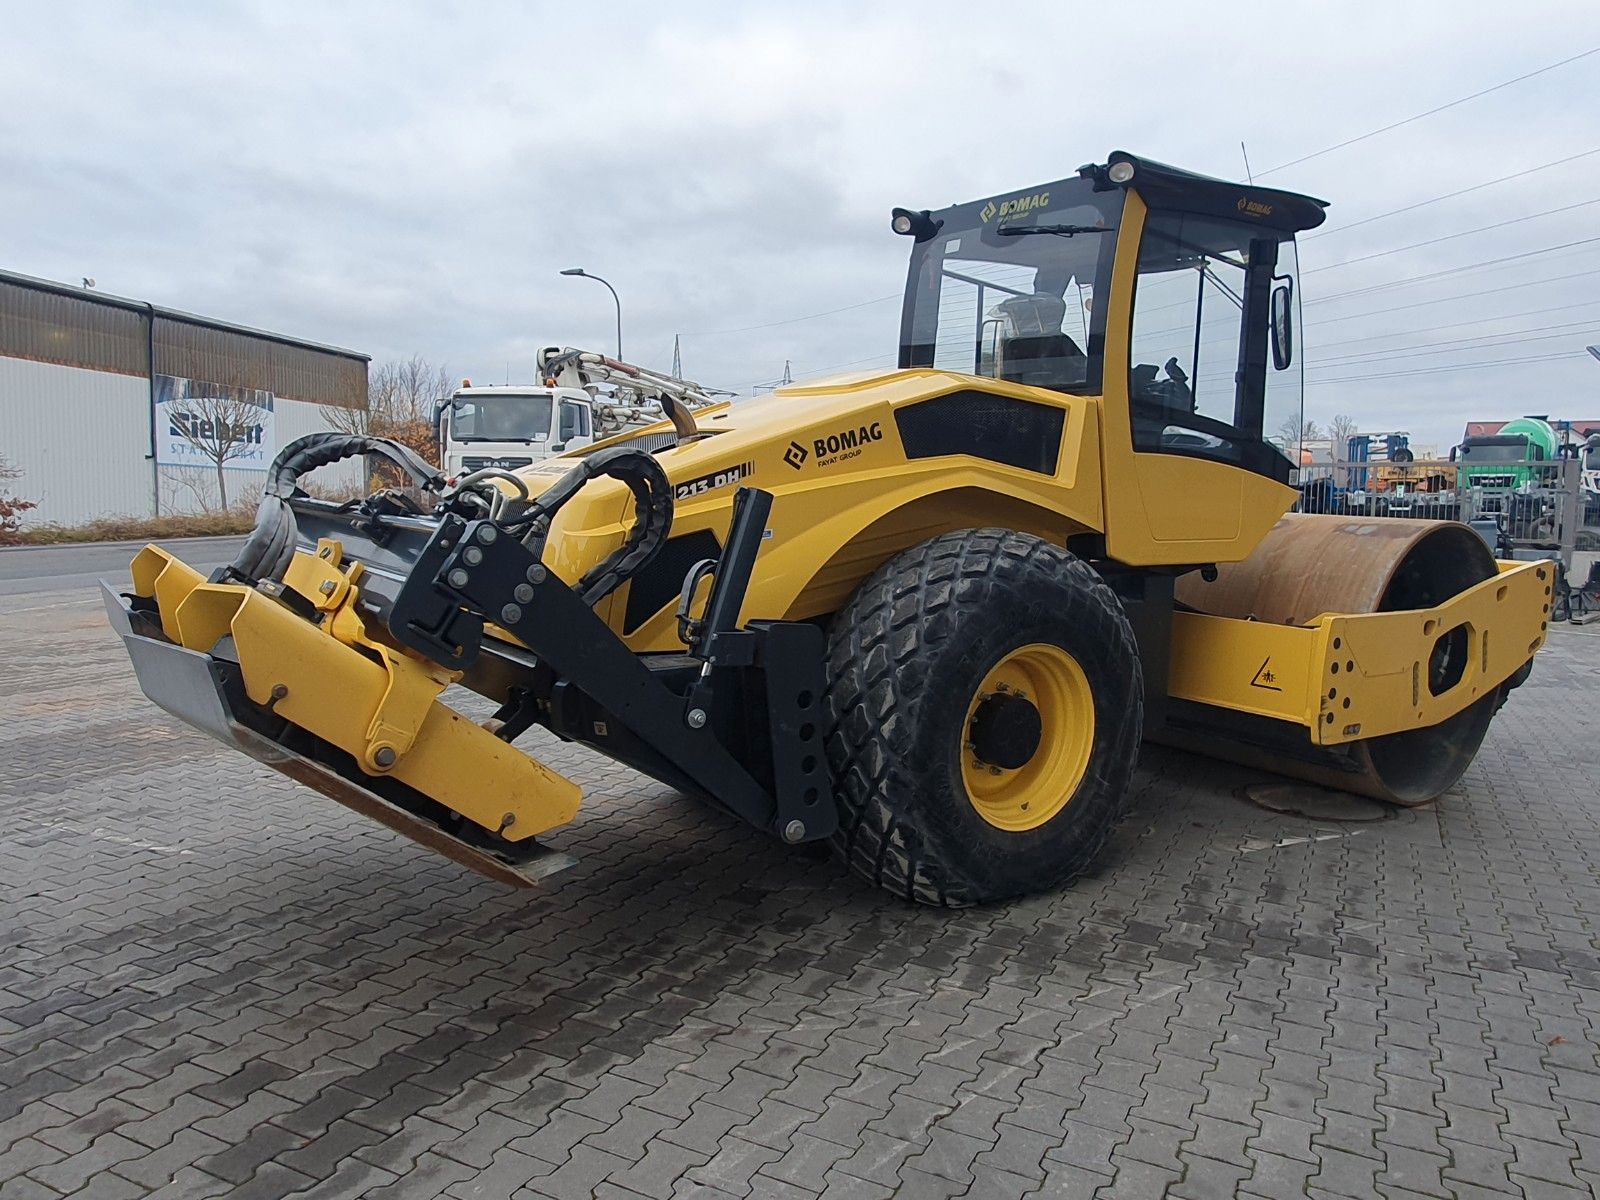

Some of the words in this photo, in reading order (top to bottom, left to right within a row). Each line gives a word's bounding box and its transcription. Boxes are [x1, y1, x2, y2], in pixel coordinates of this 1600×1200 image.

[998, 191, 1050, 217] BOMAG
[813, 422, 883, 459] BOMAG
[817, 456, 838, 468] FAYAT
[840, 449, 862, 461] GROUP
[677, 480, 709, 500] 213
[714, 469, 740, 488] DH
